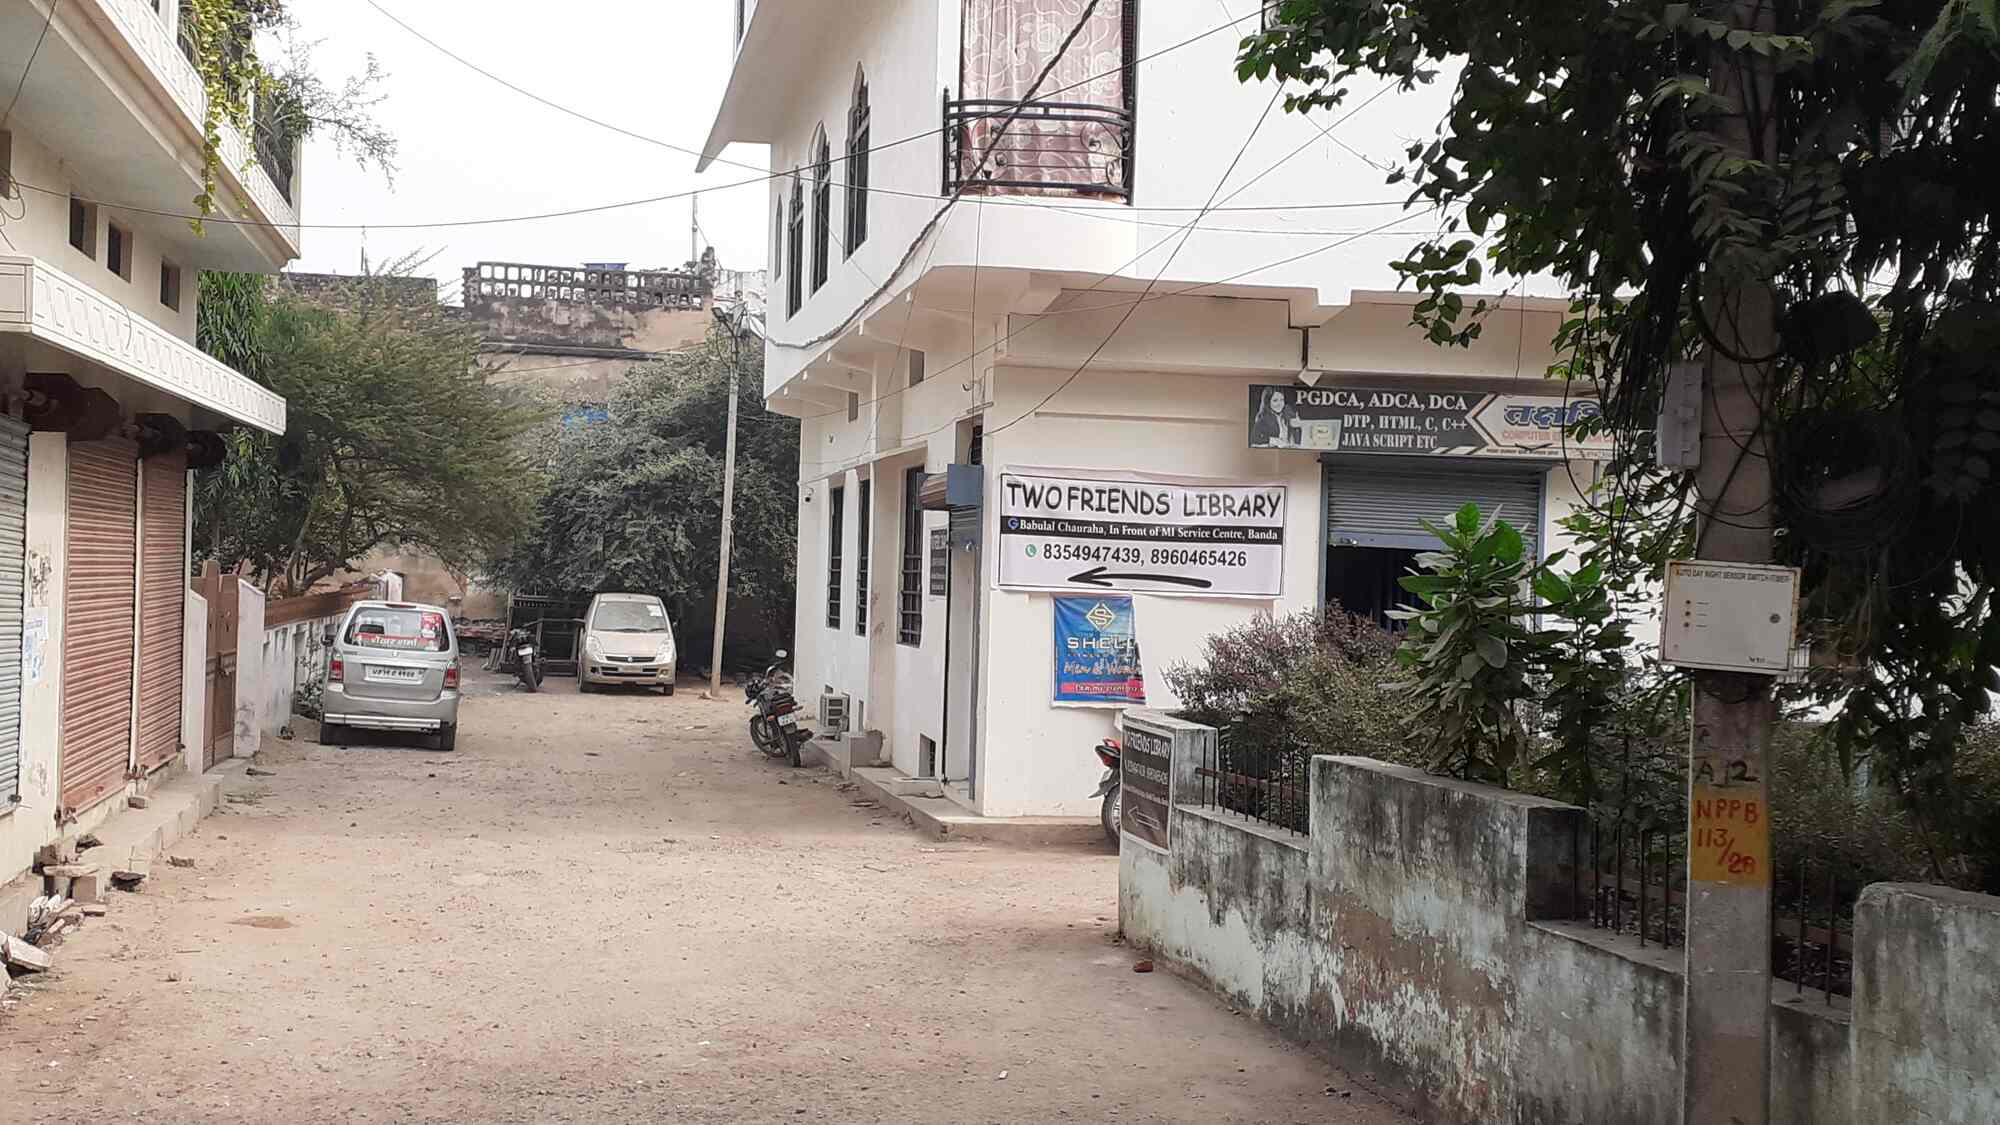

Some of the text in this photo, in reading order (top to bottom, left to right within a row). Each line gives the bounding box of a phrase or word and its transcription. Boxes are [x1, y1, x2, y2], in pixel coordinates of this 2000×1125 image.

[1296, 390, 1468, 411] PGDCA, ADCA, DCA
[1344, 414, 1468, 432] DTP, HTML, C, C++
[1342, 432, 1438, 449] JAVA SCRIPT ETC
[1183, 492, 1281, 518] LIBRARY
[1020, 519, 1055, 532] Babulal
[1057, 521, 1107, 536] Chauraha,
[1109, 524, 1119, 535] In
[1122, 524, 1147, 536] Front
[1149, 527, 1159, 537] of
[1161, 526, 1175, 537] MI
[1178, 527, 1211, 539] Service
[1212, 528, 1246, 540] Centre,
[1248, 528, 1278, 540] Banda
[1043, 543, 1248, 567] 8354947439, 8960465426
[1067, 636, 1135, 649] SHELL
[1697, 799, 1759, 824] NPPB
